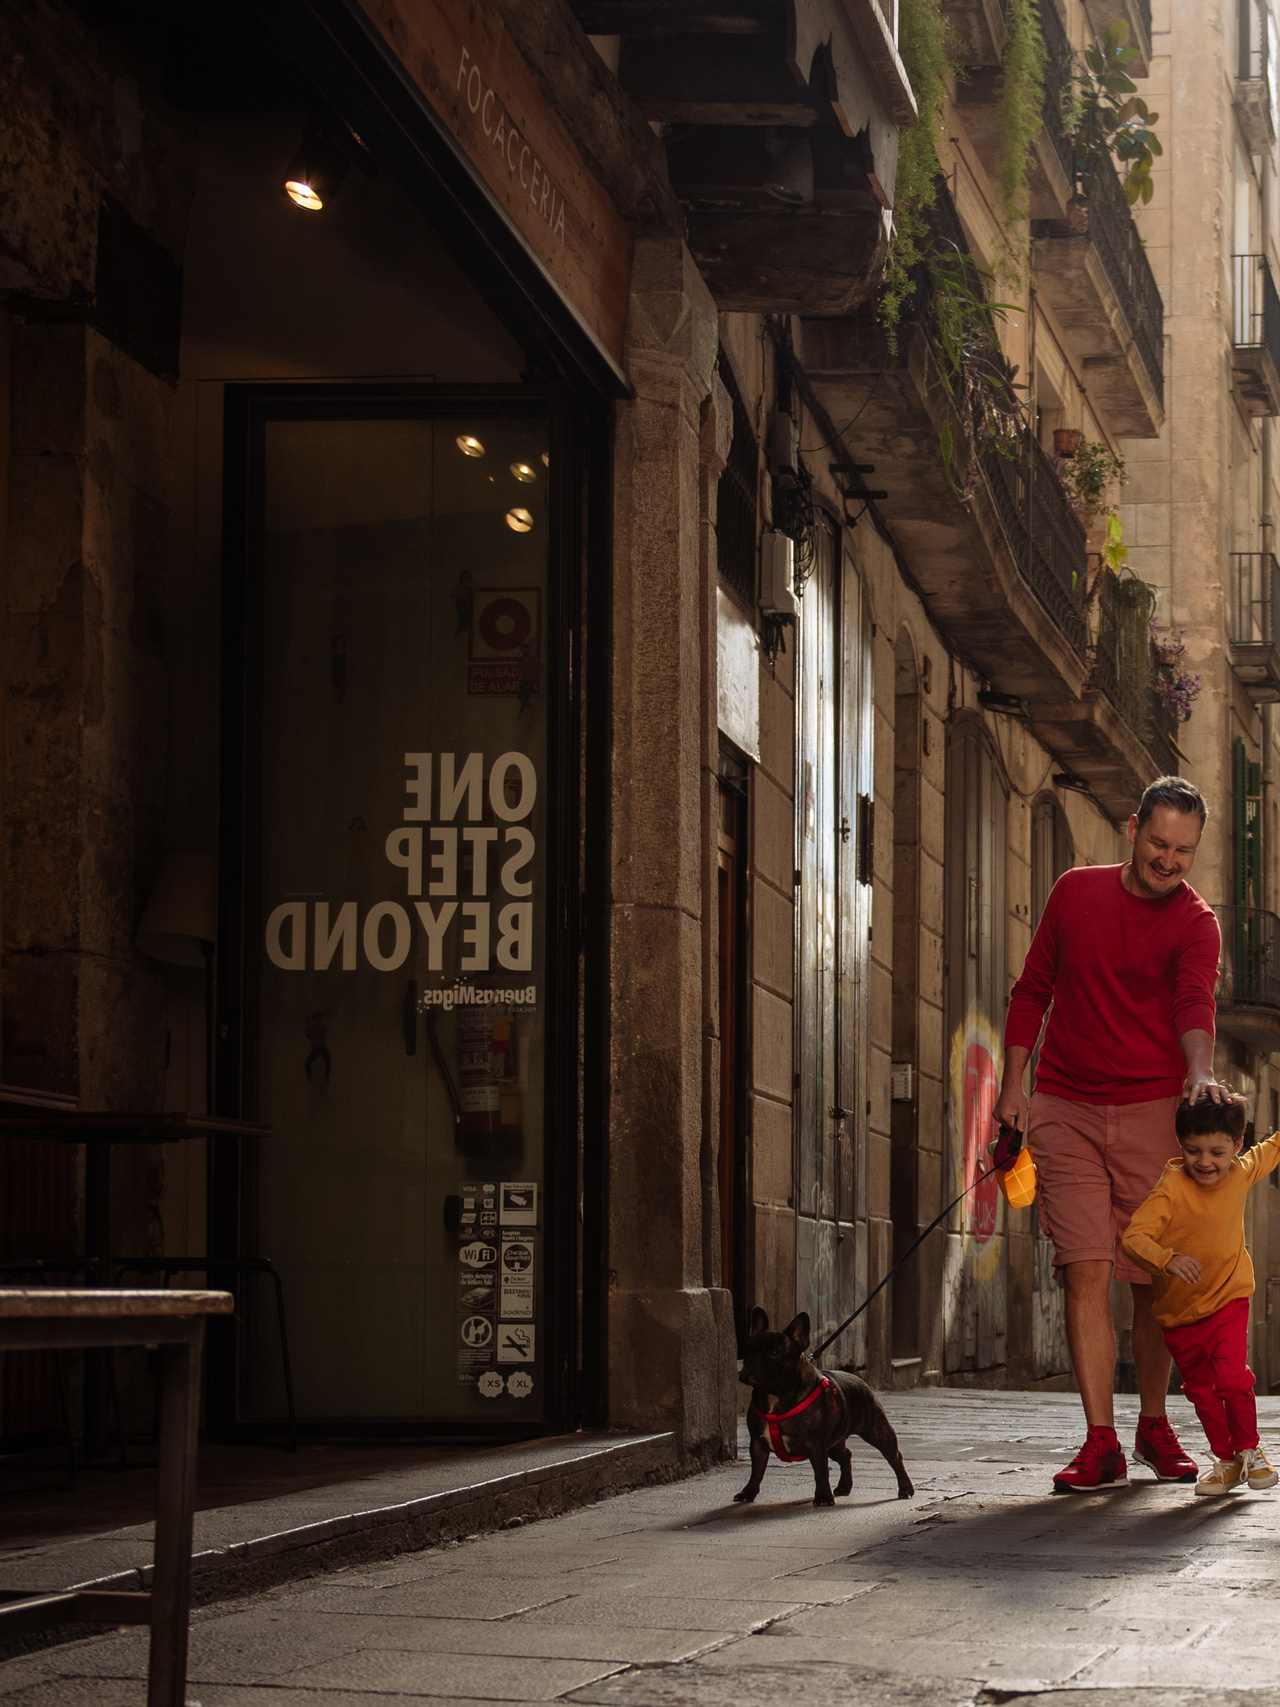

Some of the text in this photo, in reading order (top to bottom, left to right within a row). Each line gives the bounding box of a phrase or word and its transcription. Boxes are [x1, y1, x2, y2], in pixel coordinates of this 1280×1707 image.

[456, 46, 567, 244] FOCACCERIA
[472, 667, 521, 678] PULSAD
[470, 681, 538, 692] DE ALAR
[487, 1379, 501, 1388] XS
[516, 1379, 529, 1388] XL
